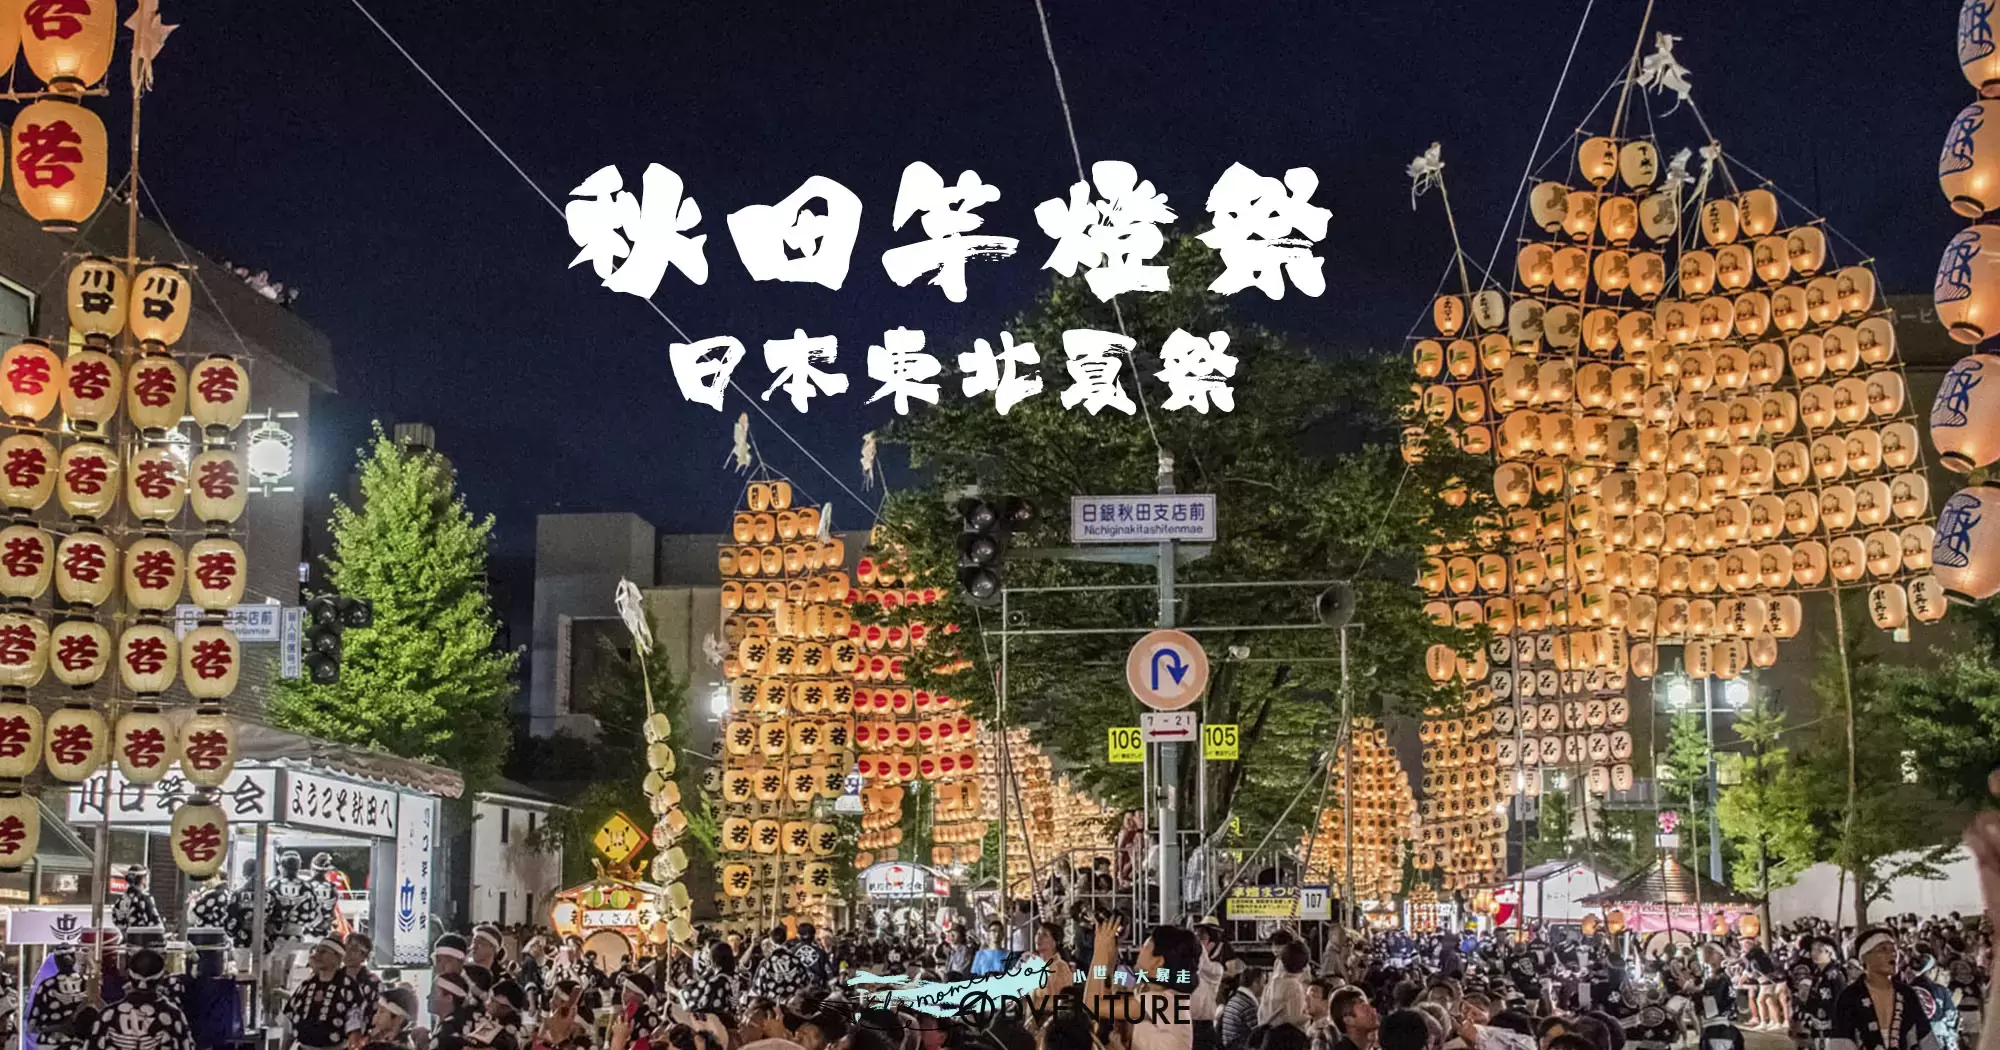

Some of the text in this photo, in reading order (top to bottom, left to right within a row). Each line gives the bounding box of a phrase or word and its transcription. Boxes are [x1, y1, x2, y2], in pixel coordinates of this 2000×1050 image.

[16, 119, 83, 189] 若
[80, 269, 114, 316] 川口
[142, 275, 179, 322] 川口
[7, 355, 51, 395] 若
[69, 361, 110, 400] 若
[134, 366, 176, 406] 若
[197, 366, 239, 404] 若
[3, 448, 47, 488] 若
[65, 456, 108, 495] 若
[136, 460, 177, 499] 若
[198, 460, 239, 499] 若
[1082, 503, 1205, 522] 日銀秋田支店前
[2, 537, 44, 577] 若
[63, 544, 106, 583] 若
[133, 551, 176, 590] 若
[196, 552, 236, 590] 若
[184, 611, 272, 625] 日支店前
[0, 624, 37, 665] 若
[57, 635, 98, 671] 若
[126, 637, 167, 674] 若
[747, 645, 765, 663] 若
[776, 647, 794, 665] 若
[803, 648, 821, 666] 若
[837, 645, 855, 663] 若
[191, 638, 232, 679] 若
[739, 685, 757, 703] 若
[767, 686, 785, 704] 若
[804, 687, 823, 704] 若
[833, 686, 851, 704] 若
[0, 716, 31, 758] 若
[51, 724, 93, 765] 若
[124, 728, 165, 768] 若
[735, 728, 753, 746] 若
[767, 729, 785, 747] 若
[800, 728, 818, 745] 若
[830, 728, 847, 746] 若
[1111, 730, 1142, 749] 106
[1206, 727, 1236, 746] 105
[187, 731, 228, 770] 若
[79, 775, 266, 815] 川口竿会
[732, 777, 750, 796] 若
[762, 775, 780, 793] 若
[795, 775, 813, 793] 若
[825, 773, 844, 791] 若
[291, 780, 393, 829] ようこそ秋田へ
[0, 816, 26, 855] 若
[180, 823, 221, 863] 若
[731, 825, 749, 844] 若
[760, 826, 778, 845] 若
[791, 828, 809, 847] 若
[819, 831, 837, 850] 若
[731, 871, 749, 889] 若
[811, 868, 829, 887] 若
[1305, 893, 1322, 908] 107
